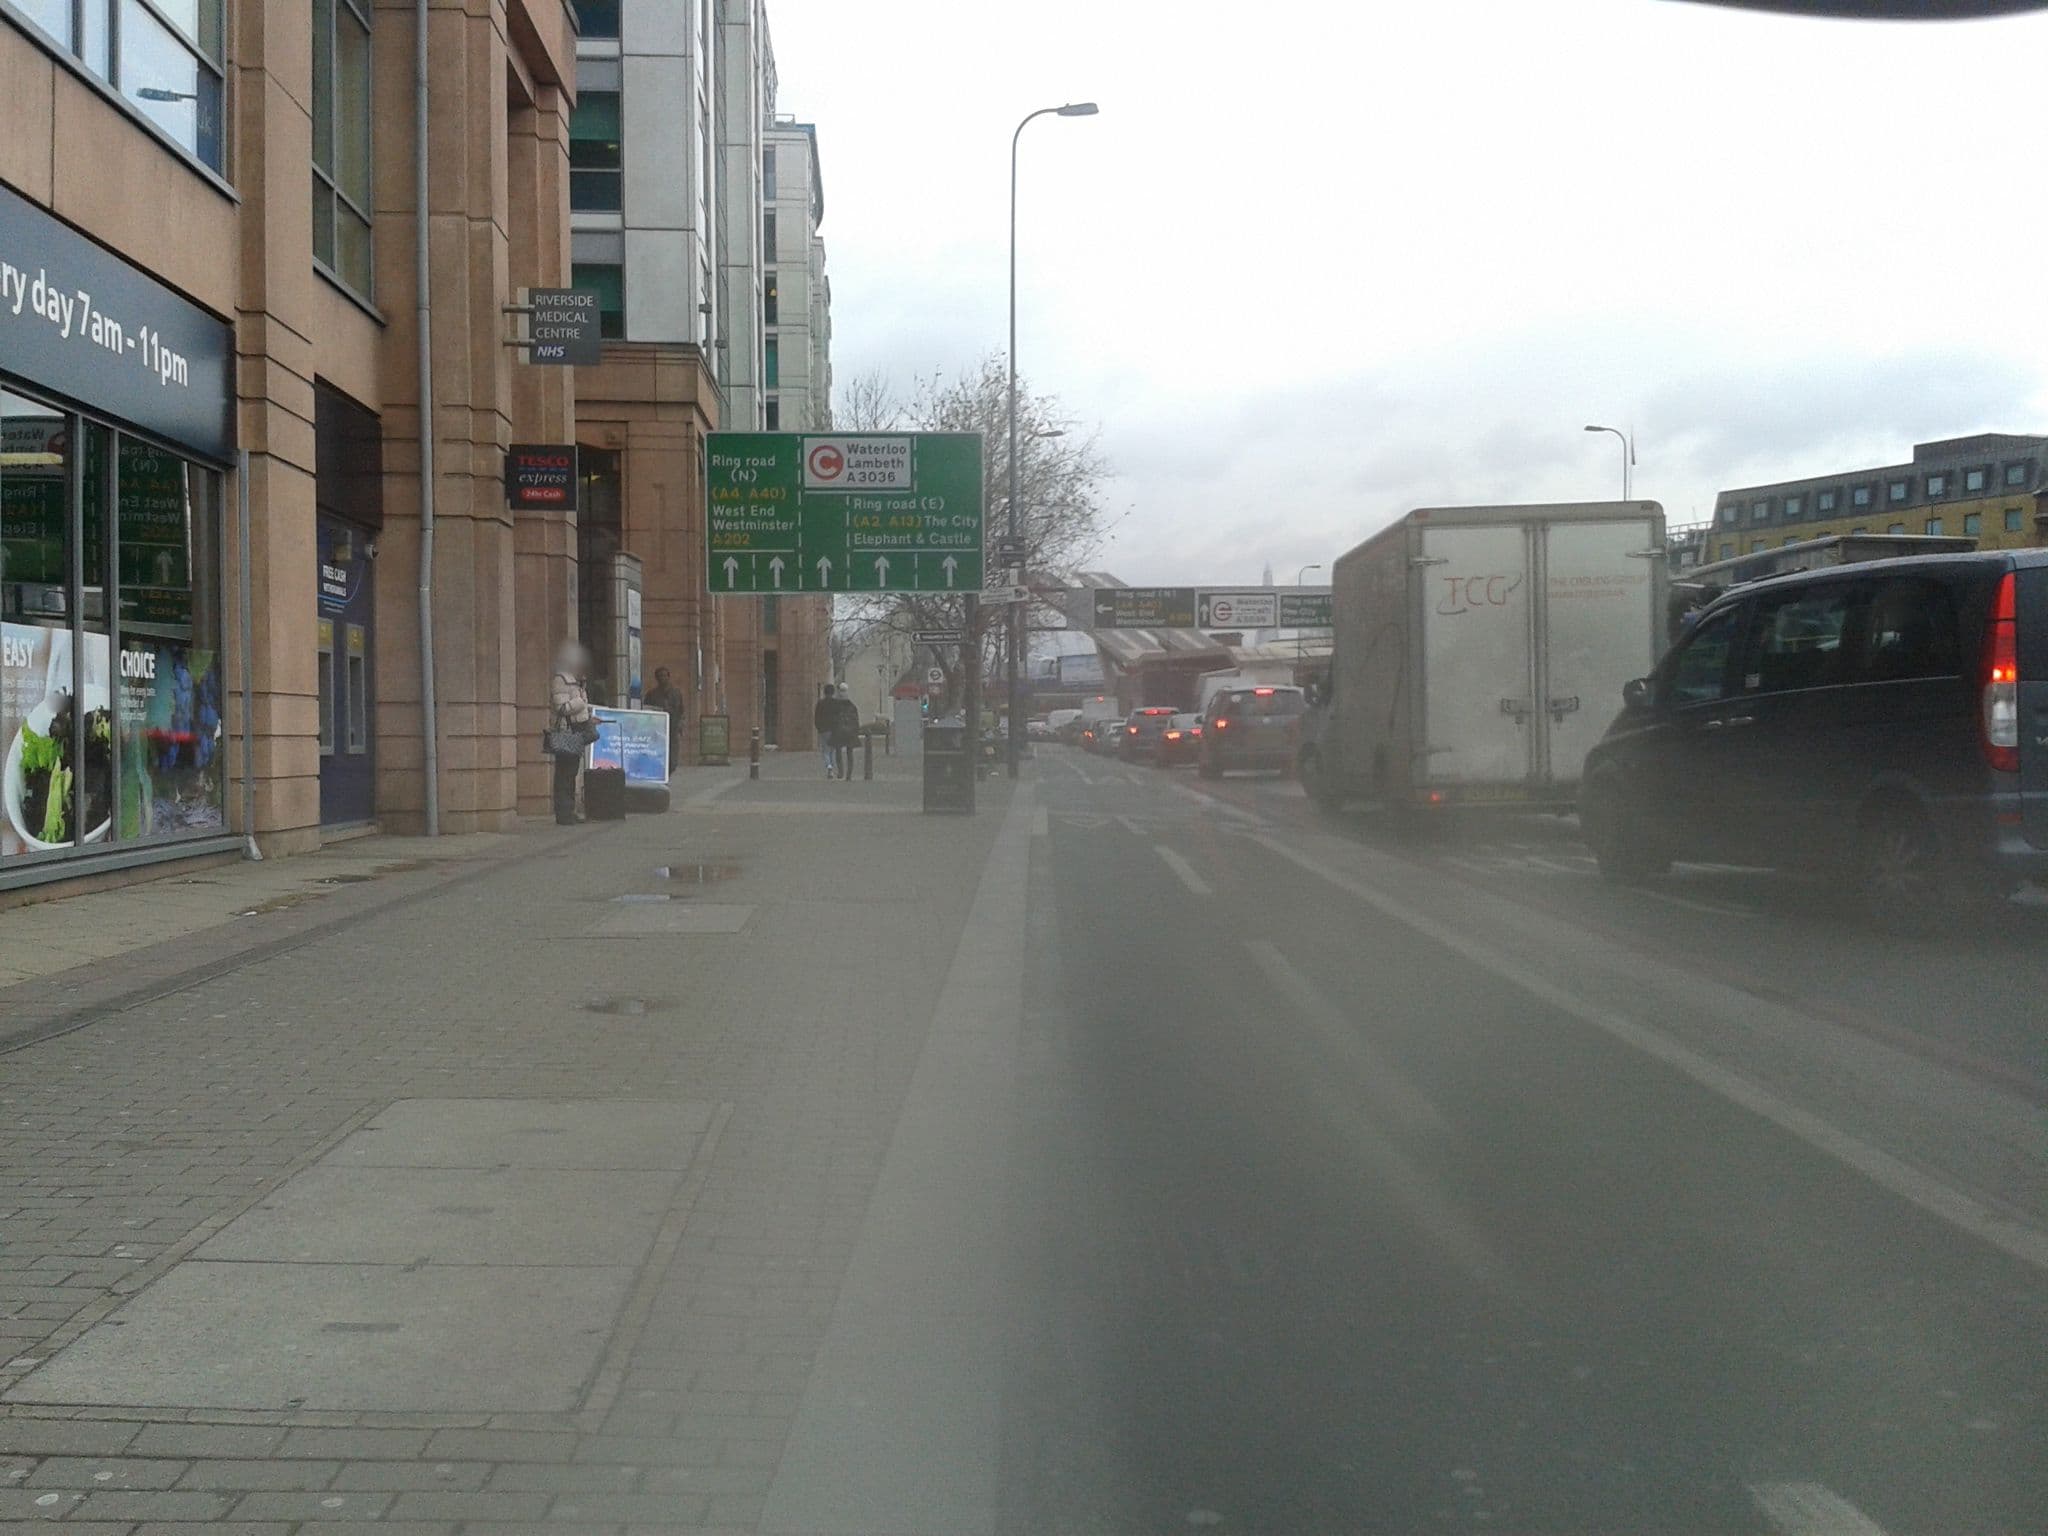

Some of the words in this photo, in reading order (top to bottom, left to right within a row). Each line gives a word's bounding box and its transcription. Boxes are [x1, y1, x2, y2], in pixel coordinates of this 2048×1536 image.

[535, 294, 594, 307] RIVERSIDE
[535, 311, 589, 323] MEDICAL
[0, 261, 27, 315] ry
[31, 268, 74, 339] day
[77, 290, 123, 354] 7am
[139, 325, 188, 387] 11pm
[535, 327, 581, 339] CENTRE
[537, 345, 565, 357] NHS
[846, 443, 907, 455] Waterloo
[712, 454, 741, 468] Ring
[746, 455, 776, 467] road
[846, 457, 905, 469] Lambeth
[518, 473, 568, 485] express
[731, 468, 757, 482] (N)
[846, 471, 897, 482] A3036
[711, 487, 740, 499] (A4
[749, 487, 787, 500] A40)
[712, 504, 745, 517] West
[750, 504, 775, 517] End
[854, 498, 882, 512] Ring
[887, 498, 917, 510] road
[921, 496, 945, 510] (E)
[712, 520, 795, 531] Westminster
[924, 515, 948, 528] The
[951, 514, 979, 529] City
[712, 533, 750, 545] A202
[854, 532, 912, 546] Elephant
[916, 533, 925, 545] &
[929, 532, 972, 545] Castle
[4, 636, 34, 669] EASY
[120, 649, 156, 679] CHOICE
